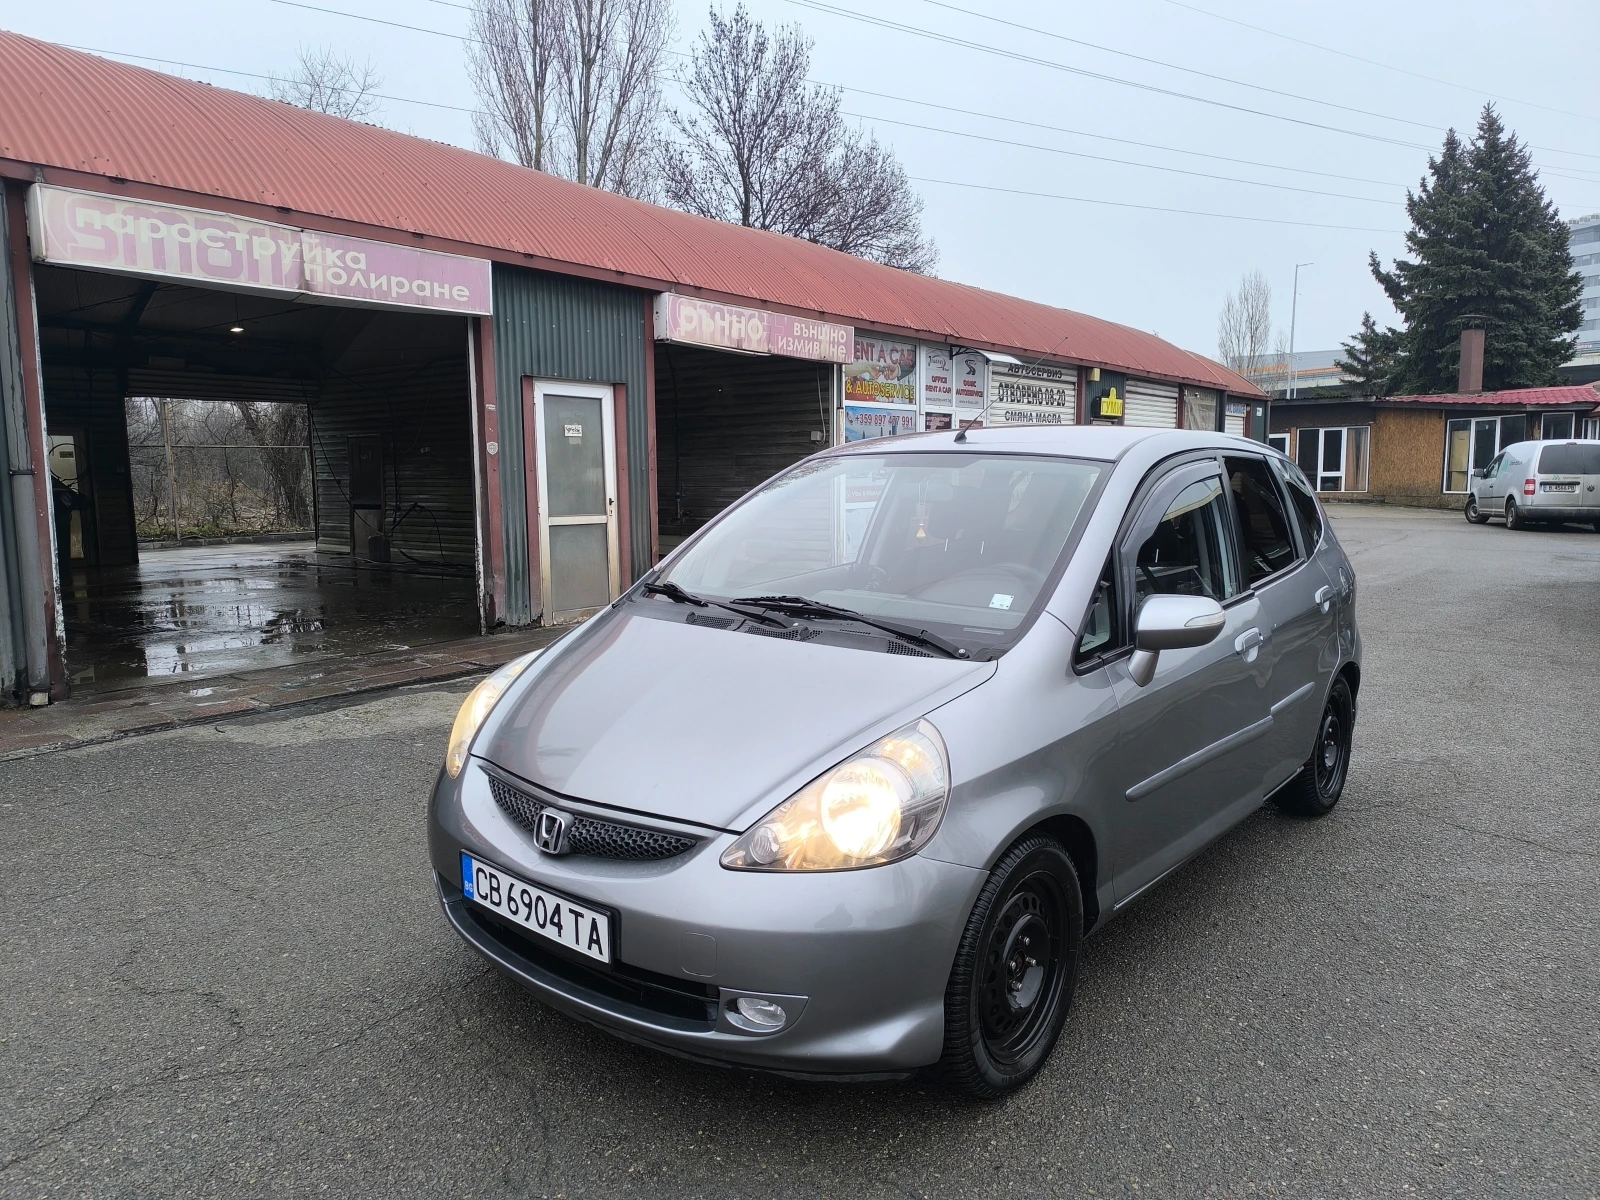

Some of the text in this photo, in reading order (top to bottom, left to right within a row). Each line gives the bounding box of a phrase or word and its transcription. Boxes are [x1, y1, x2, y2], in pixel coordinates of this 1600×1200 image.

[76, 206, 366, 274] пароструйка
[304, 262, 470, 302] полиране
[854, 340, 914, 367] ENT A CAR
[1007, 363, 1063, 379] АВТОСЕРВИЗ
[846, 381, 914, 399] & AUTOSERVICE
[998, 382, 1043, 405] ОТВОРЕНО
[1101, 401, 1122, 415] ГУМИ
[855, 413, 872, 424] +359
[902, 415, 913, 426] 991
[1004, 411, 1062, 424] СМЯНА МАСЛА
[464, 880, 473, 893] BG
